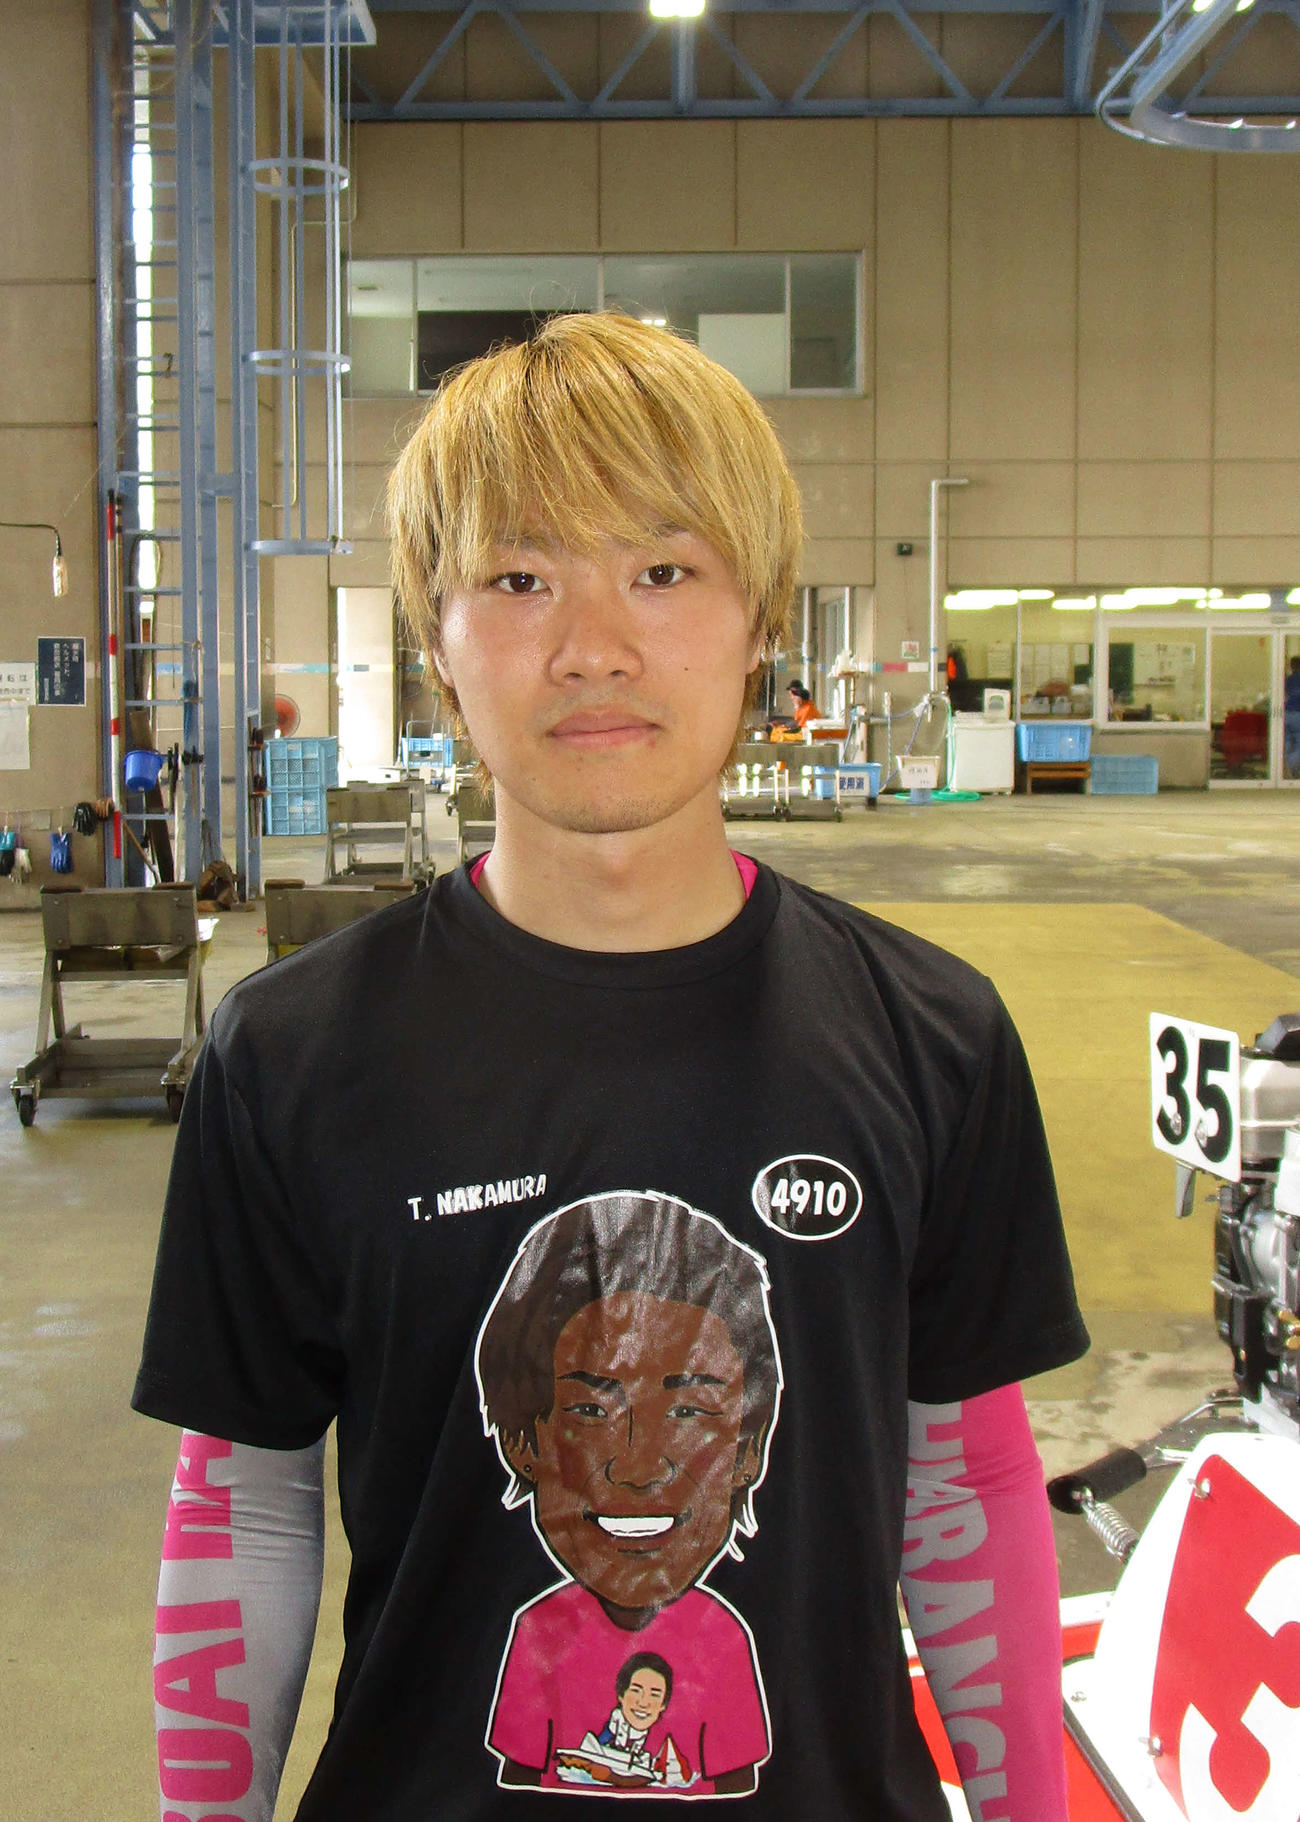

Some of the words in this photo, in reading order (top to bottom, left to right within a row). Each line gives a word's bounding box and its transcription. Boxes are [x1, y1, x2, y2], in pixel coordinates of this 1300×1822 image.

[1157, 1026, 1233, 1163] 35
[407, 1197, 432, 1221] T.
[437, 1174, 547, 1216] NAKAMURA
[771, 1179, 847, 1216] 4910
